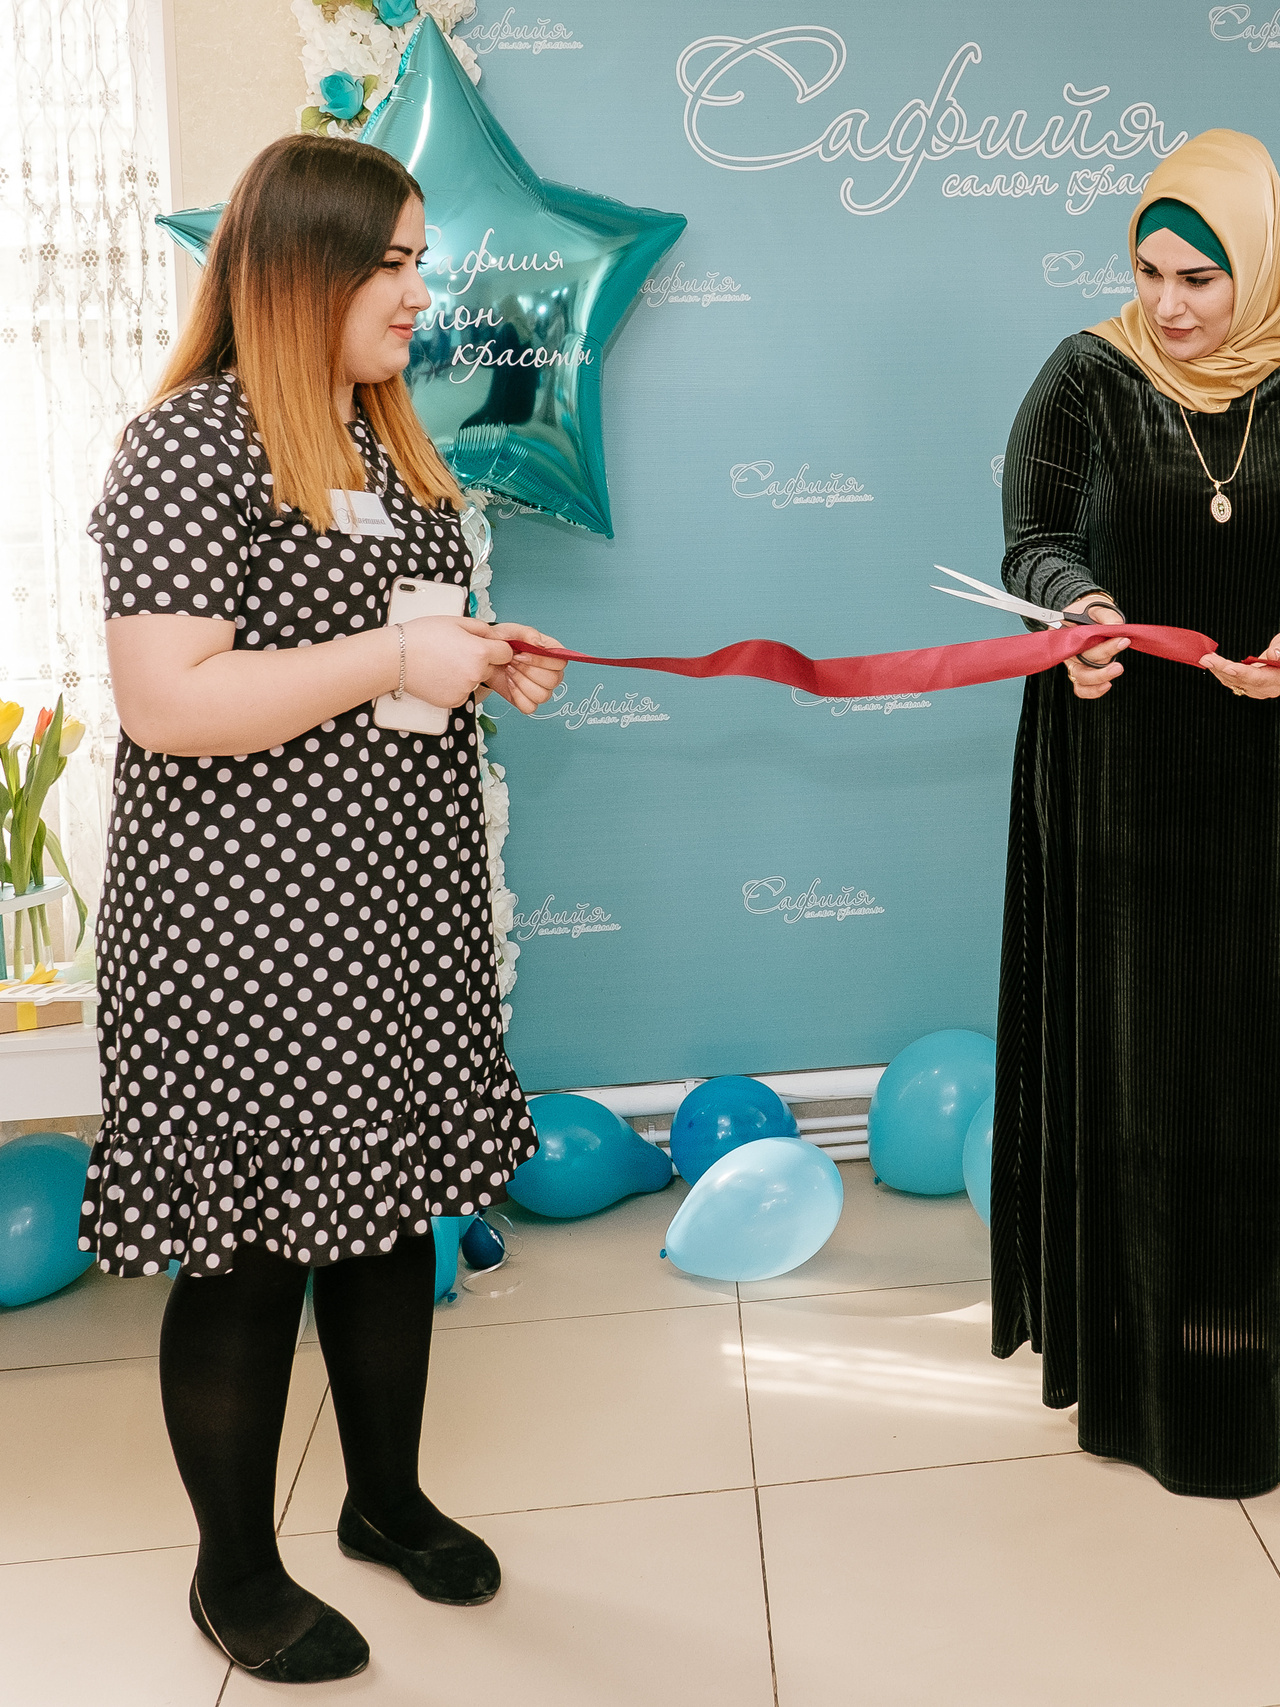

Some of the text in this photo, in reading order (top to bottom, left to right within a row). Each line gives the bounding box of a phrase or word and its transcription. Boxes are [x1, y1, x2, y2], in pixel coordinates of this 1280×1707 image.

[461, 7, 574, 54] афийя
[676, 25, 1188, 216] Сафийя
[942, 167, 1059, 198] салон
[639, 260, 742, 308] афийя
[411, 304, 504, 332] лон
[449, 339, 595, 384] красоты
[512, 892, 612, 941] афийя
